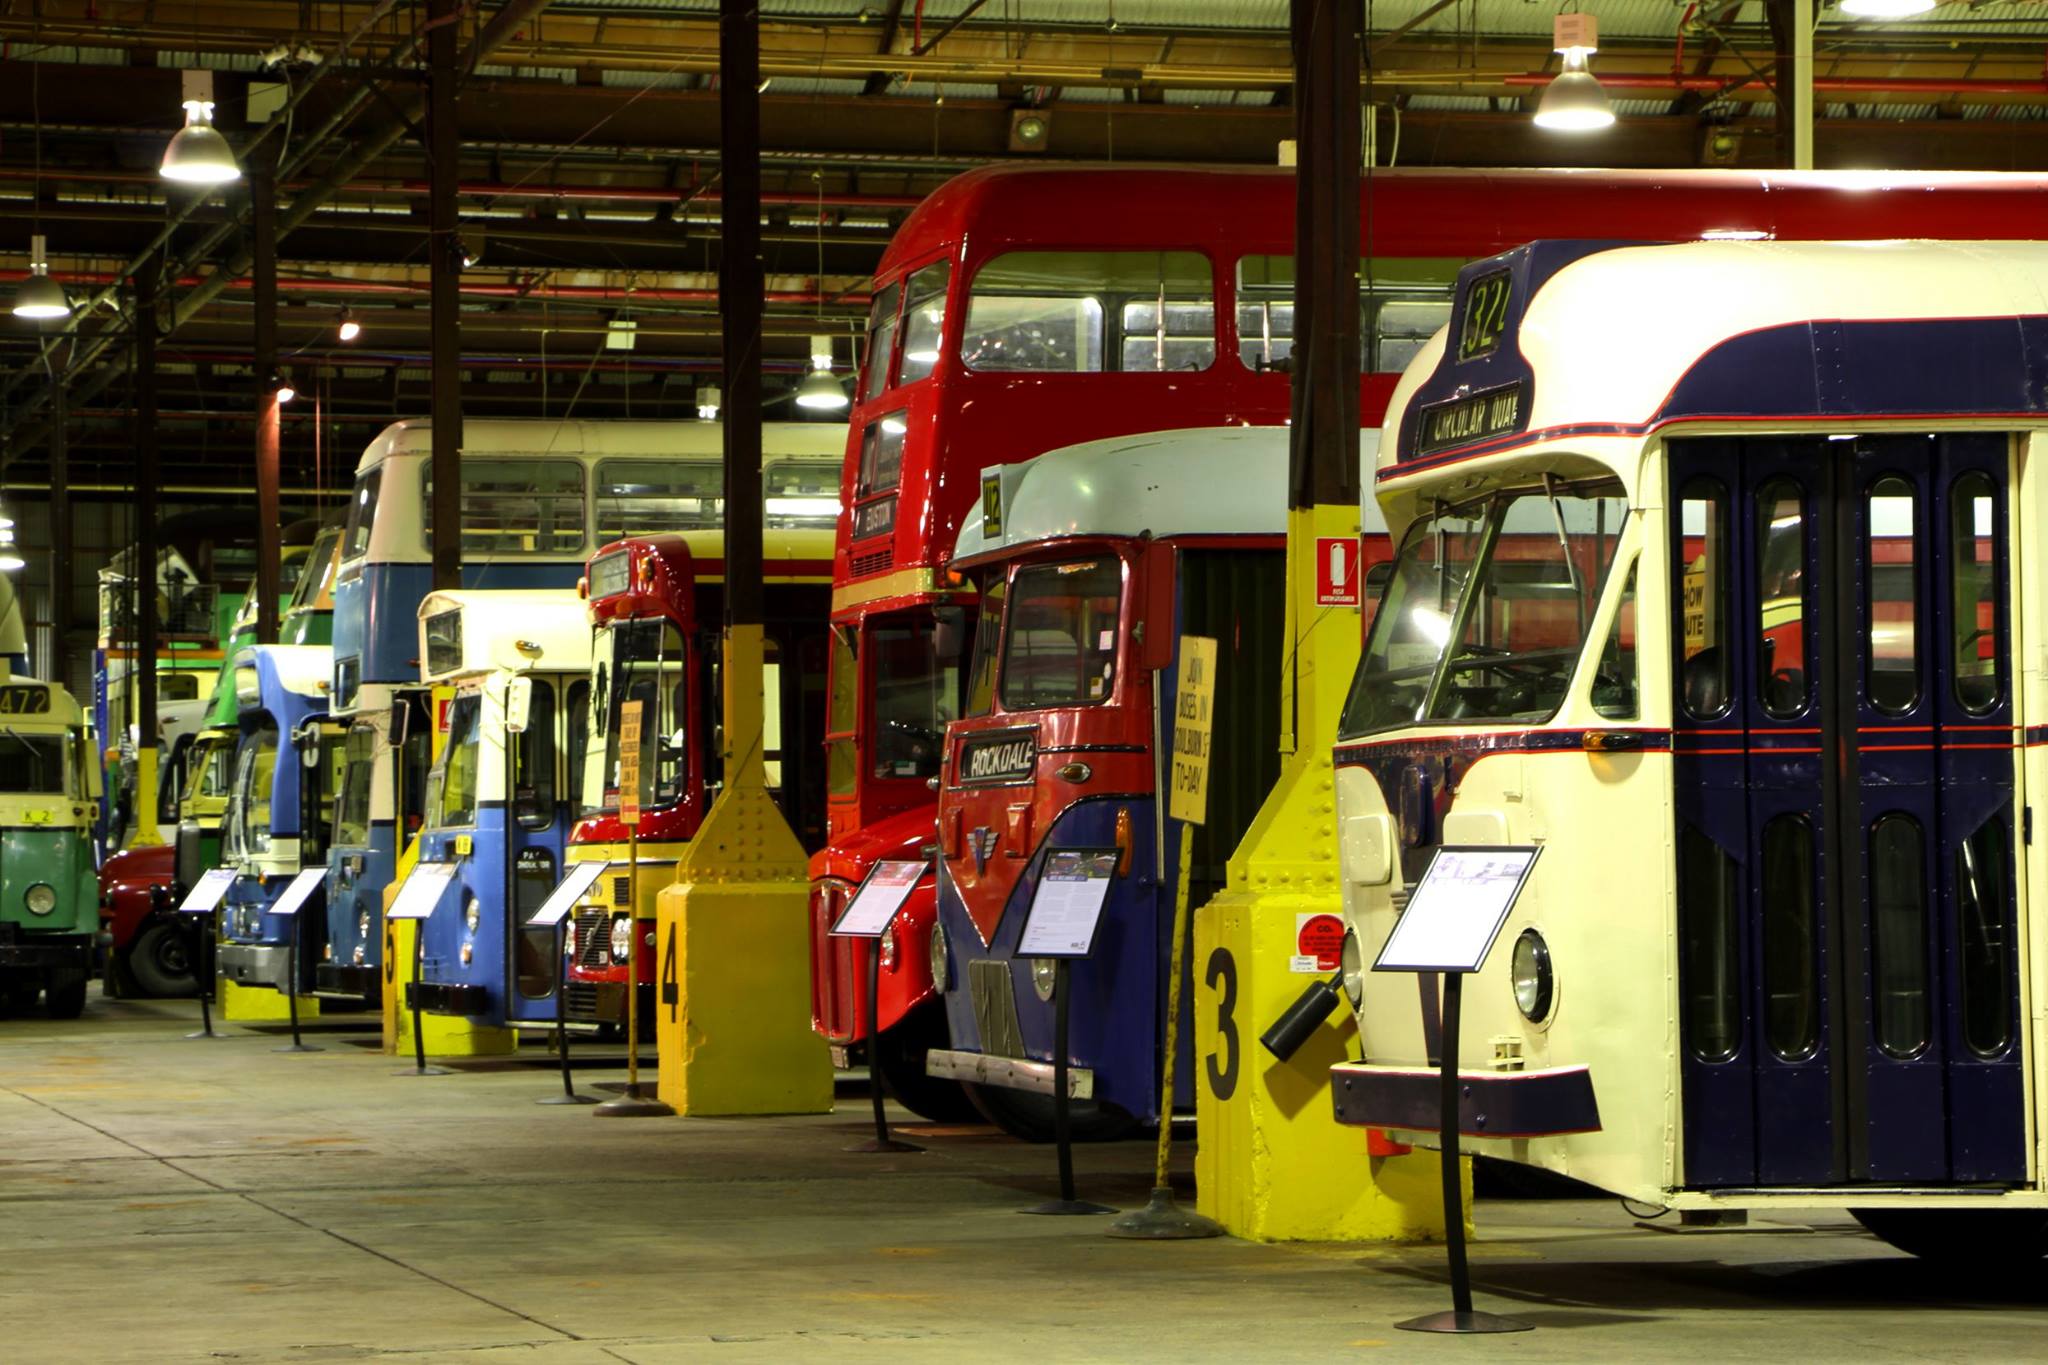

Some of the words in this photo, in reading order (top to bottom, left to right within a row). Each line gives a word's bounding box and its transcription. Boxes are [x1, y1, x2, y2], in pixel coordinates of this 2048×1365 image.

[1435, 401, 1486, 441] CIRCULAR
[1490, 392, 1519, 431] QUAY
[1, 689, 48, 714] 472
[1179, 691, 1197, 721] BUSES
[971, 741, 1034, 777] ROCKDALE
[1175, 761, 1203, 795] TO-DAY
[43, 810, 50, 820] 2
[386, 919, 394, 985] 5
[662, 921, 679, 1024] 4
[1205, 946, 1240, 1101] 3
